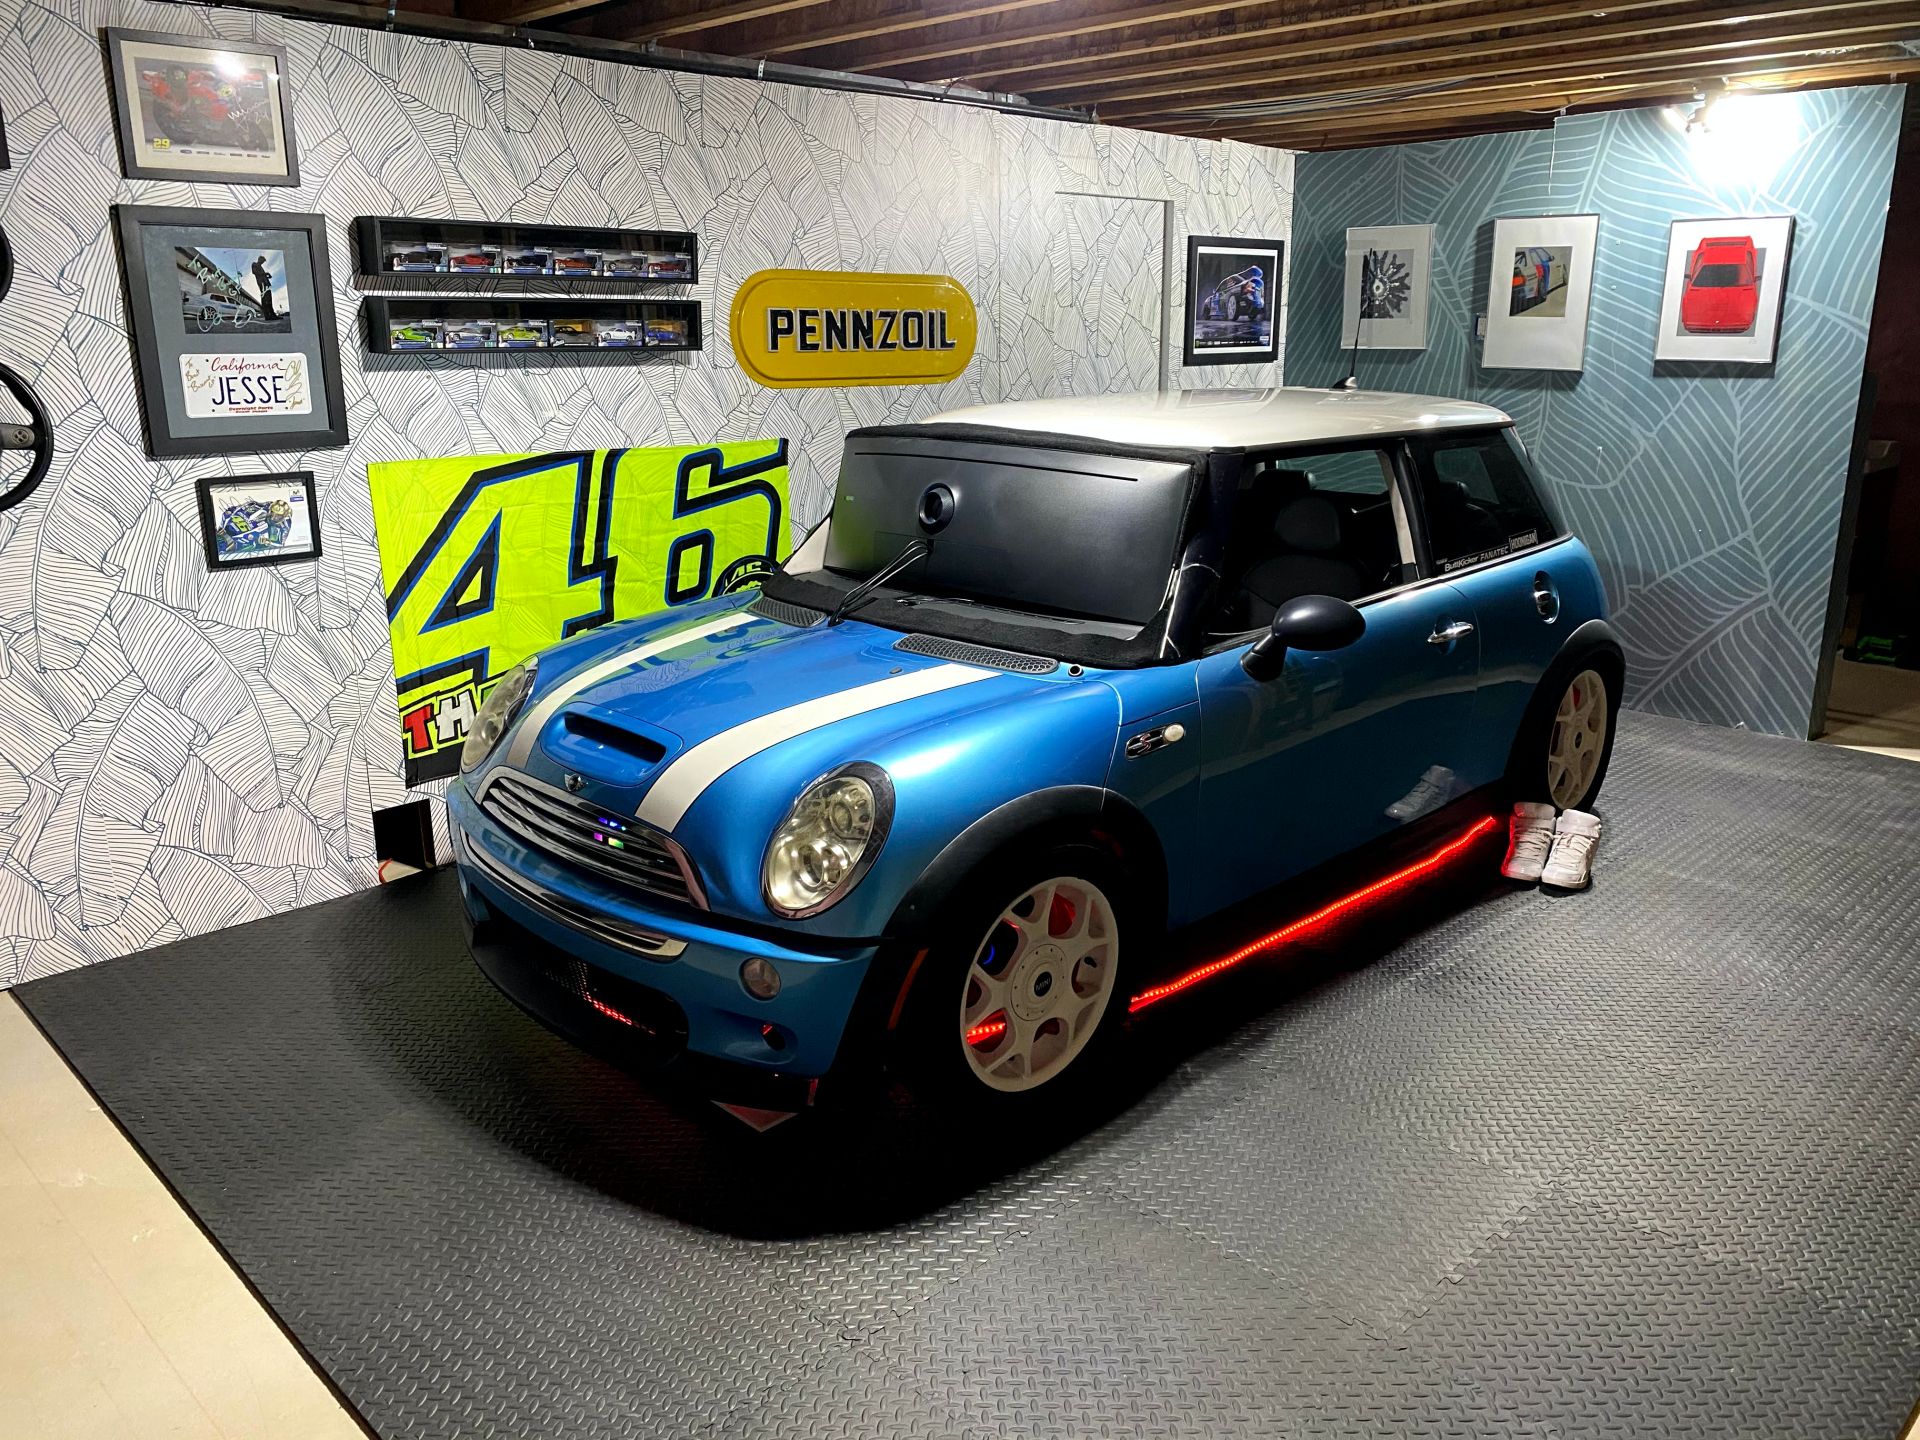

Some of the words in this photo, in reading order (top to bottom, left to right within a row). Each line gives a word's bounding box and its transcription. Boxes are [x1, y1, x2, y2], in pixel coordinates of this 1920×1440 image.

[153, 137, 171, 149] 29
[767, 307, 957, 352] PENNZOIL
[211, 357, 286, 374] California
[212, 376, 286, 405] JESSE
[386, 440, 788, 690] 46
[1480, 546, 1509, 561] FANATEC
[403, 684, 495, 754] TH
[1036, 978, 1051, 991] MINI
